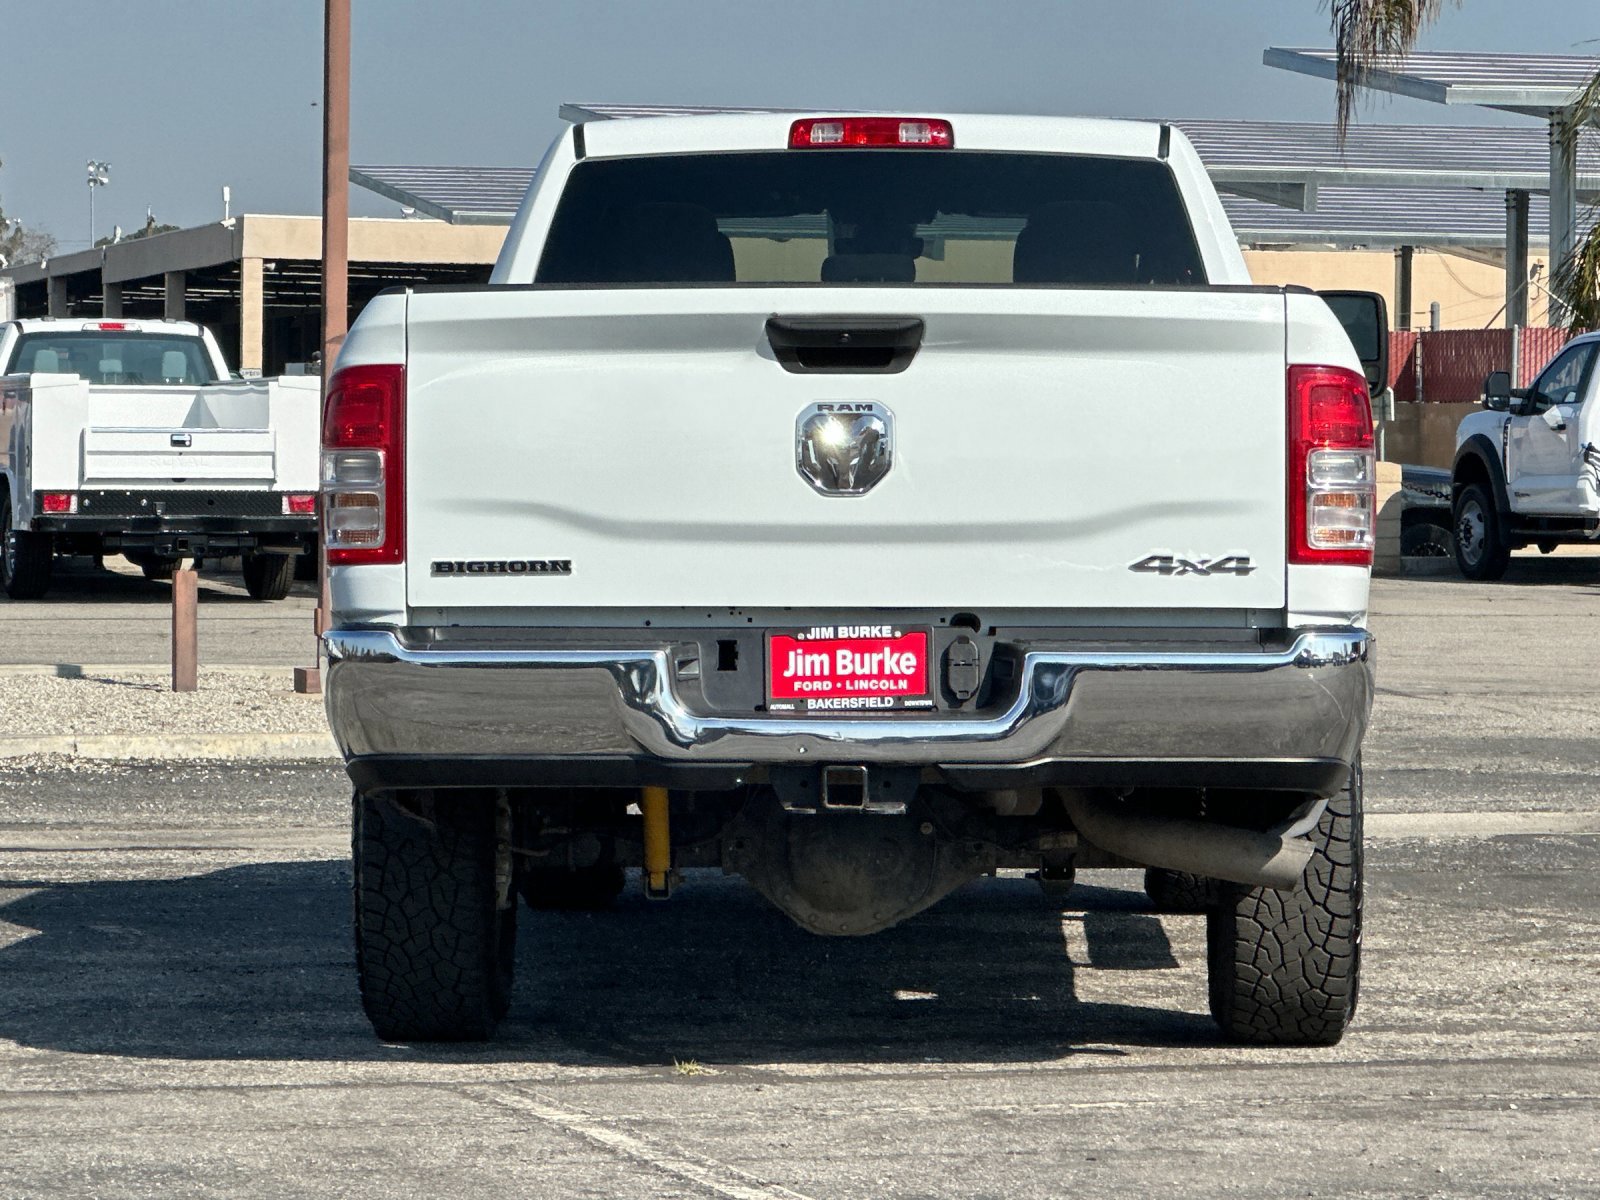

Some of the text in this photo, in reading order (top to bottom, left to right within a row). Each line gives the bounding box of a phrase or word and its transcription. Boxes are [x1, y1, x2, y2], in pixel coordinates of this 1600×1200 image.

[817, 404, 873, 412] RAM
[430, 559, 572, 577] BIGHORN
[807, 625, 892, 639] JIM BURKE
[783, 647, 917, 677] Jim Burke
[794, 679, 908, 692] FORD LINCOLN
[807, 697, 894, 710] BAKERSFIELD
